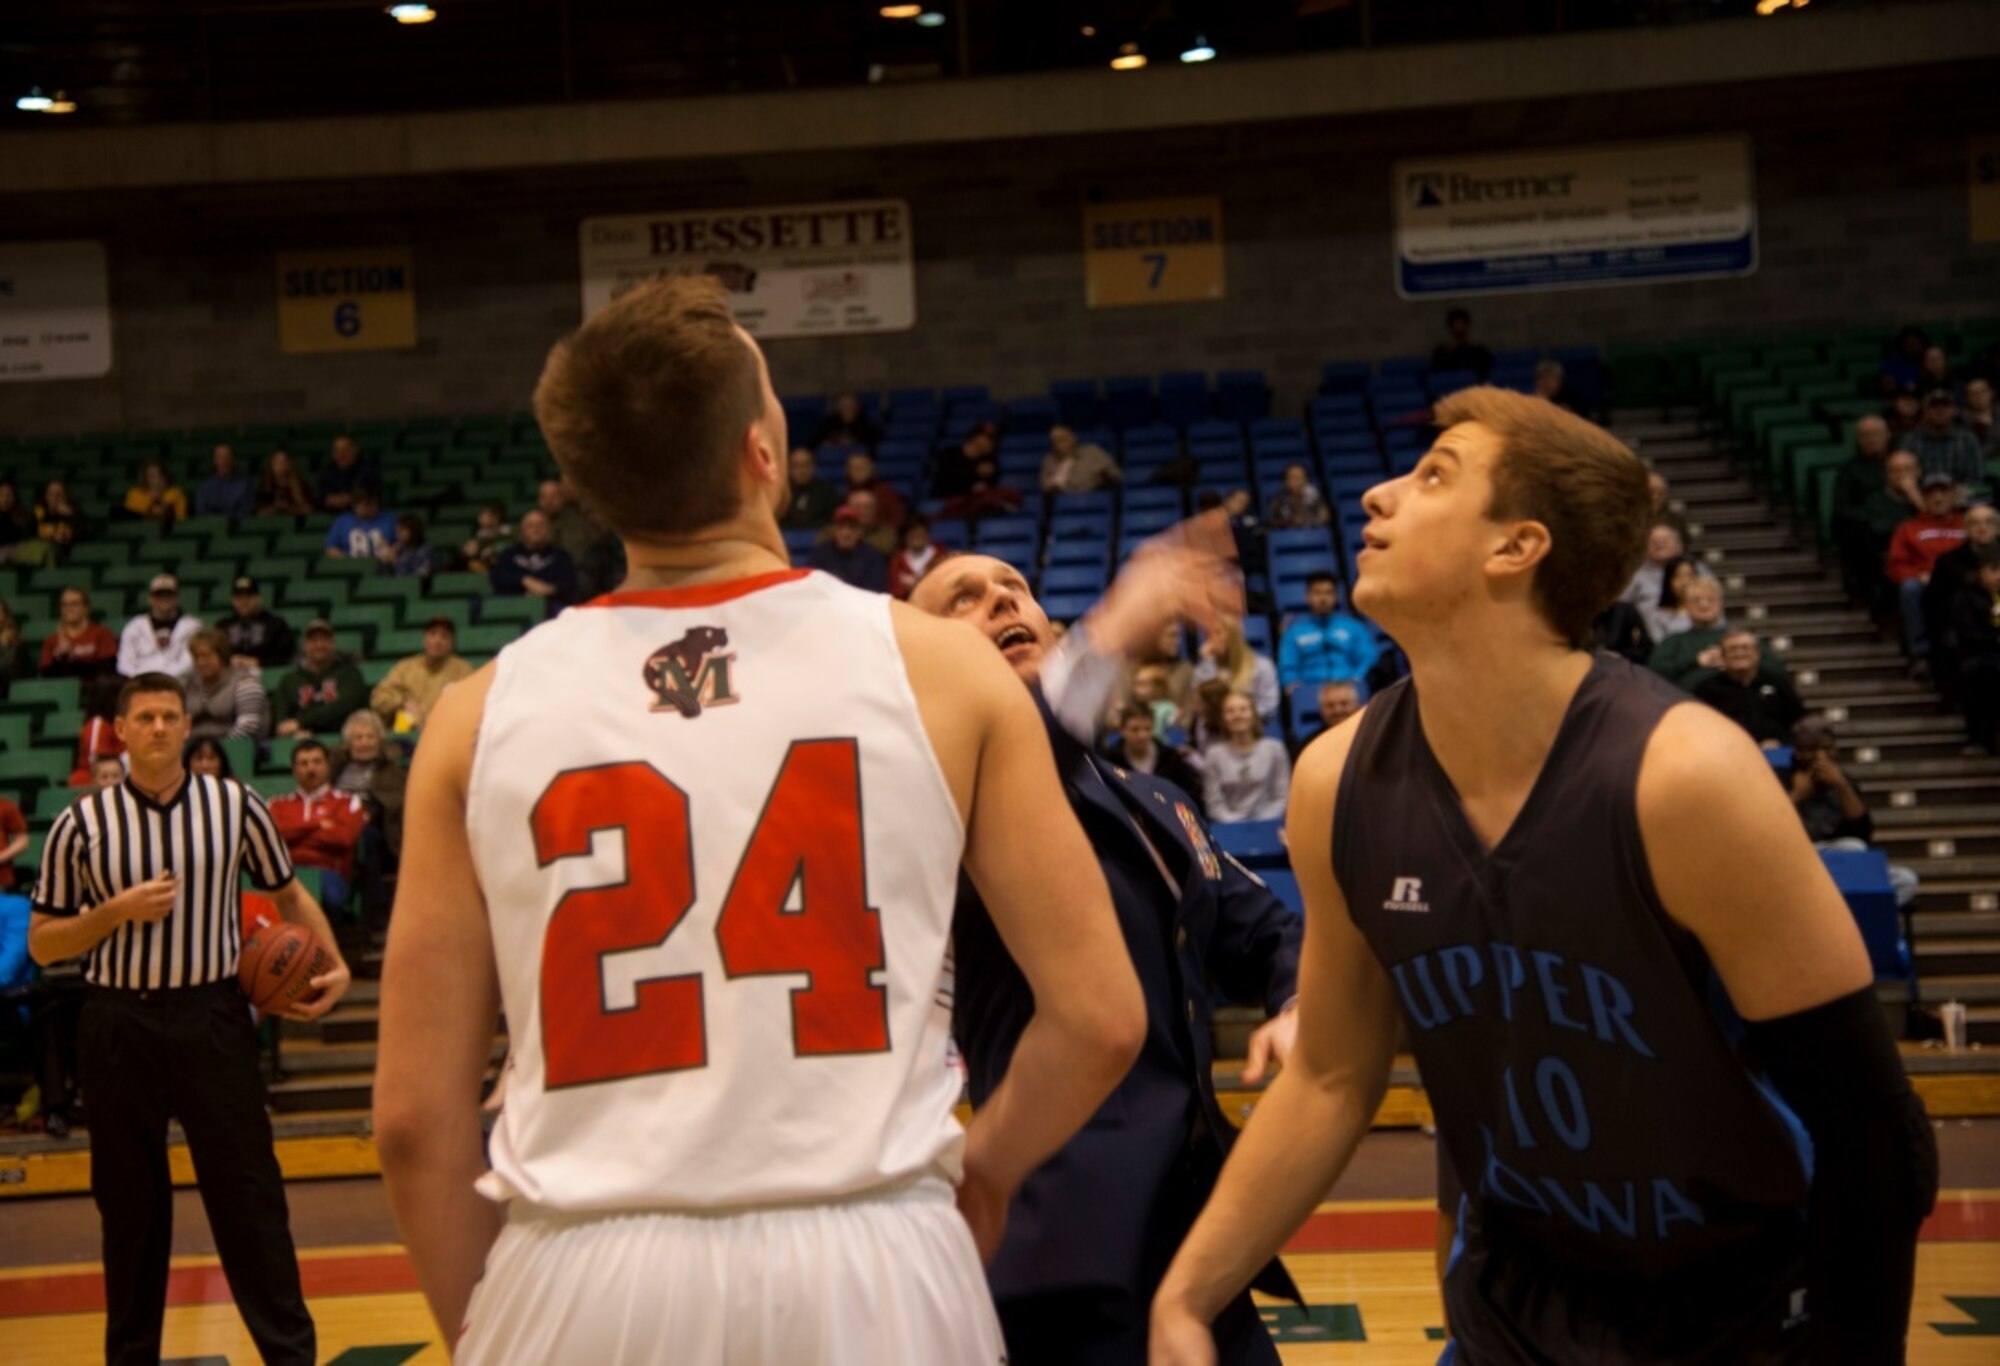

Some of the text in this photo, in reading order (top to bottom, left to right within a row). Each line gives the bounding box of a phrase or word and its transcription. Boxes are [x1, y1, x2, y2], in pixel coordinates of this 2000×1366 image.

[1450, 170, 1578, 204] Bremer
[649, 208, 902, 256] BESSETTE
[1094, 216, 1214, 249] SECTION
[285, 266, 404, 298] SECTION
[1142, 253, 1168, 291] 7
[333, 302, 362, 337] 6
[530, 736, 893, 1092] 24
[1383, 900, 1430, 913] RUSSELL
[1390, 941, 1658, 1061] UPPER
[1503, 1055, 1593, 1151] 10
[1479, 1120, 1707, 1240] IOWA
